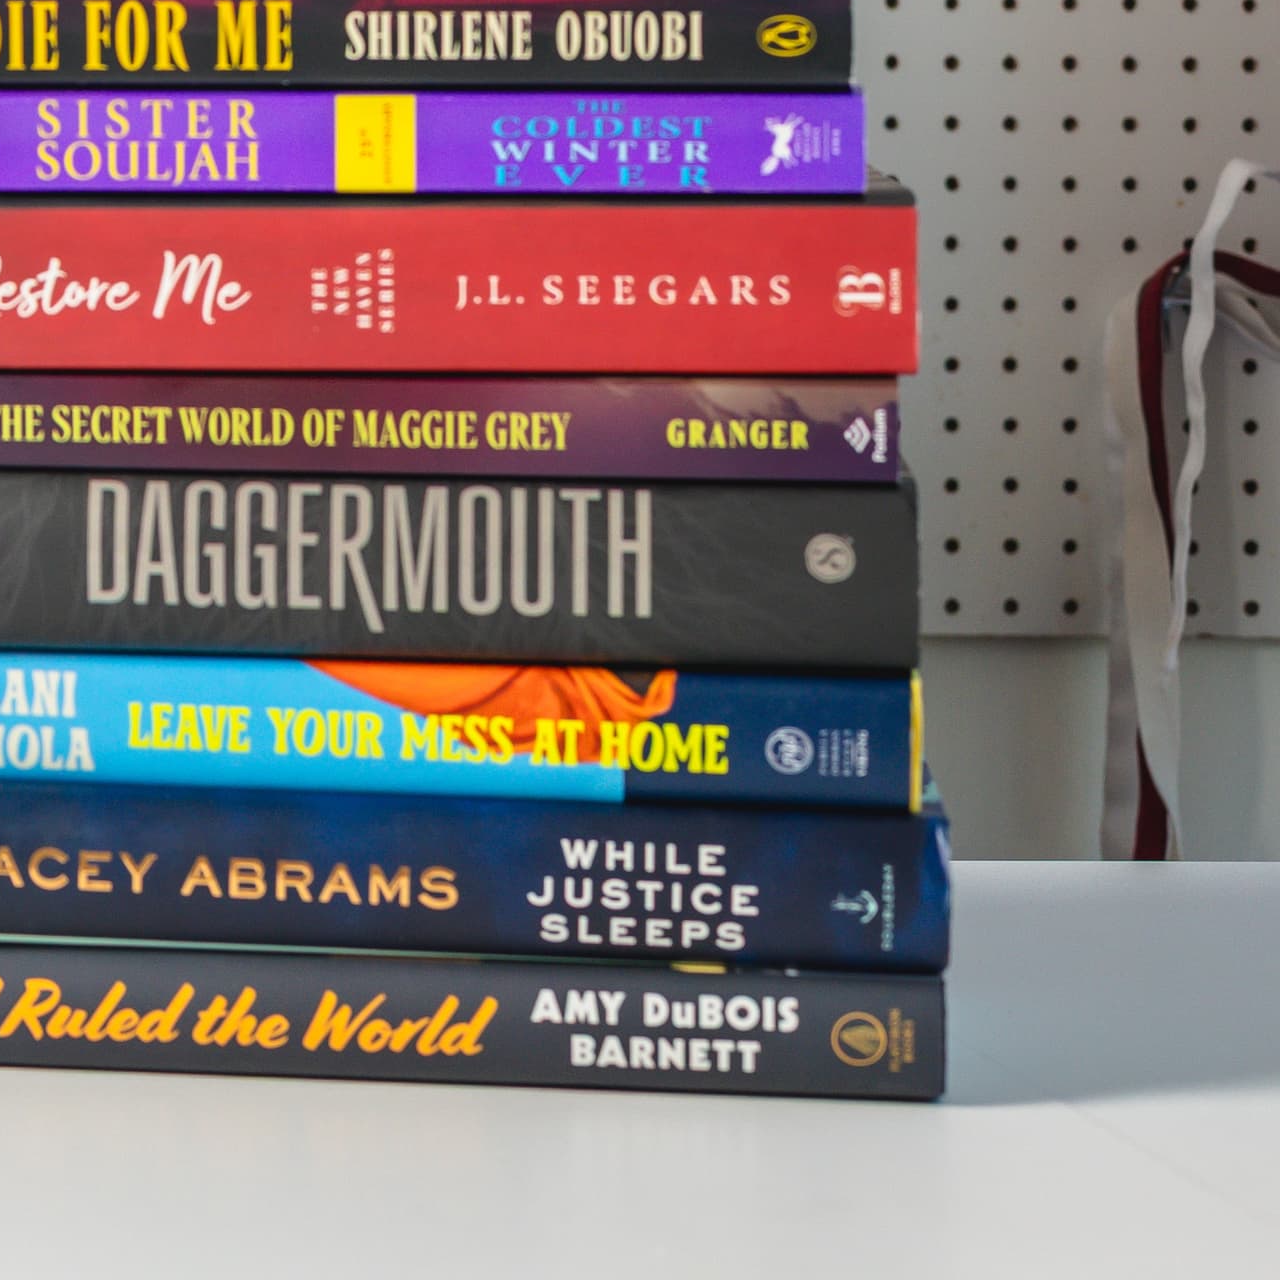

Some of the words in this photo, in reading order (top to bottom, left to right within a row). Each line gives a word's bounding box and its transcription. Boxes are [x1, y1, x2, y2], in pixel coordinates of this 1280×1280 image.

[344, 10, 533, 61] SHIRLENE
[556, 10, 704, 61] OBUOBI
[35, 98, 258, 140] SISTER
[490, 115, 713, 139] COLDEST
[574, 99, 626, 114] THE
[34, 140, 261, 186] SOULJAH
[490, 140, 710, 163] WINTER
[493, 164, 709, 188] EVER
[152, 250, 252, 325] Me
[310, 267, 328, 313] THE
[333, 266, 350, 315] NEW
[355, 252, 373, 329] HAVEN
[377, 247, 395, 333] SERIES
[456, 274, 526, 311] J.L.
[542, 274, 793, 306] SEEGARS
[52, 404, 172, 446] SECRET
[179, 407, 294, 448] WORLD
[302, 408, 345, 448] OF
[352, 410, 478, 450] MAGGIE
[485, 411, 572, 451] GREY
[666, 418, 809, 450] GRANGER
[872, 408, 888, 463] Podium
[86, 478, 653, 633] DAGGERMOUTH
[128, 702, 250, 752] LEAVE
[266, 706, 384, 760] YOUR
[400, 714, 514, 766] MESS
[531, 718, 585, 767] AT
[599, 720, 730, 775] HOME
[561, 837, 727, 877] WHILE
[180, 855, 459, 910] ABRAMS
[526, 875, 760, 917] JUSTICE
[539, 914, 746, 952] SLEEPS
[192, 984, 290, 1049] the
[302, 989, 499, 1057] World
[530, 988, 626, 1027] AMY
[643, 990, 799, 1034] DuBOIS
[570, 1034, 762, 1074] BARNETT
